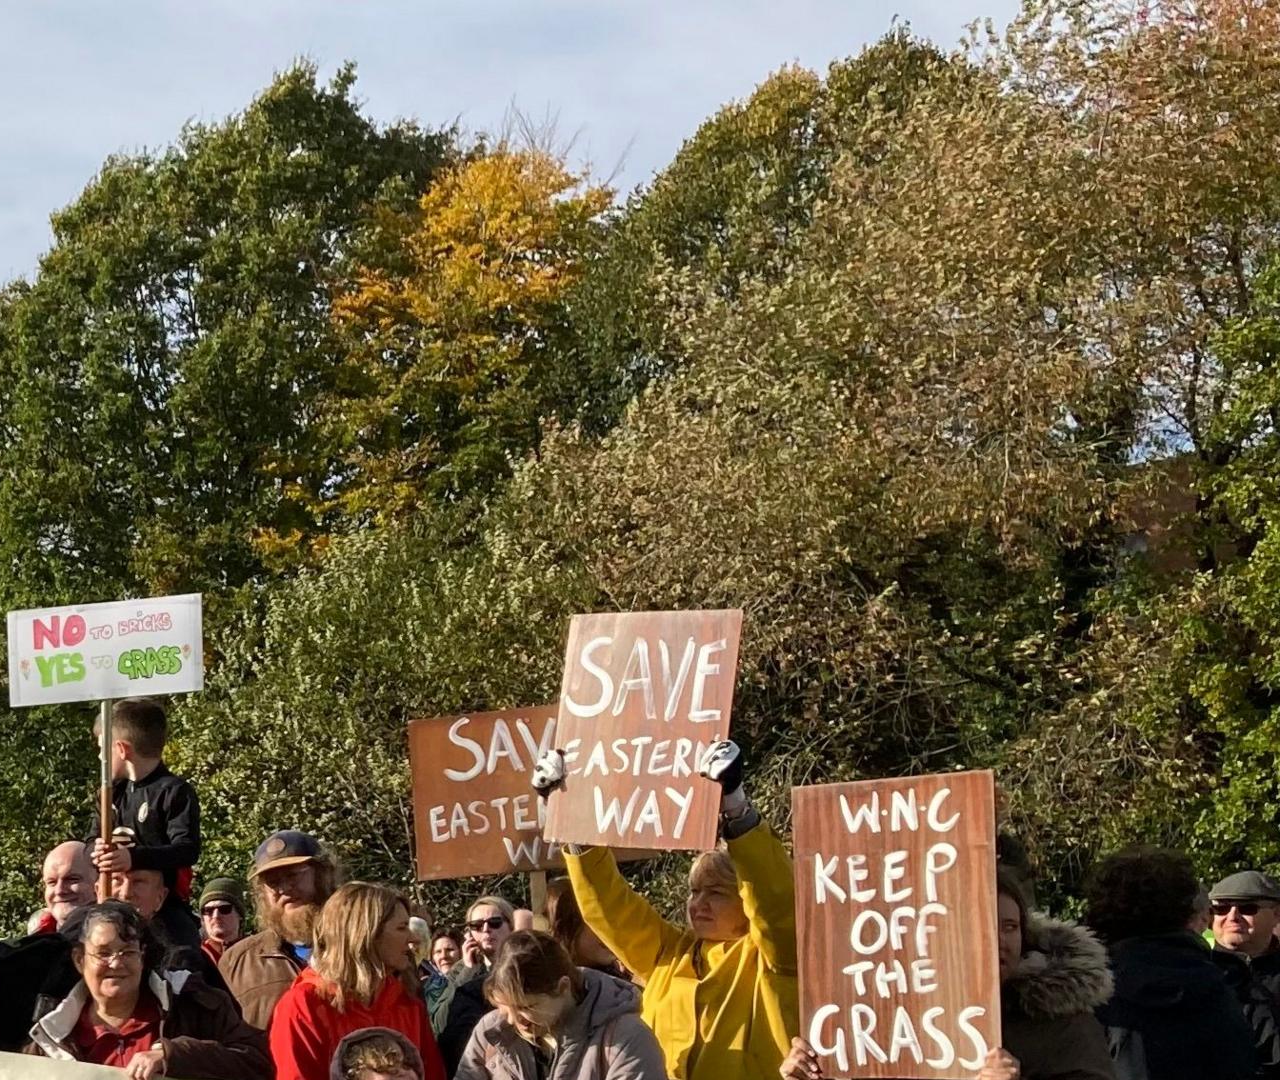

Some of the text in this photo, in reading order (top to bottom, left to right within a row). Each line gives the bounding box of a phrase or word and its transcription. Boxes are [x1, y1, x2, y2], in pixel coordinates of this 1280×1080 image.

[32, 614, 87, 650] NO
[89, 625, 114, 640] TO
[35, 645, 183, 688] YES TO GRASS
[566, 636, 727, 723] SAVE
[443, 716, 556, 782] SAV
[429, 794, 546, 843] EASTE
[593, 785, 694, 839] WAY
[814, 842, 958, 904] KEEP
[850, 902, 948, 957] OFF
[842, 958, 939, 998] THE
[809, 1003, 990, 1072] GRASS
